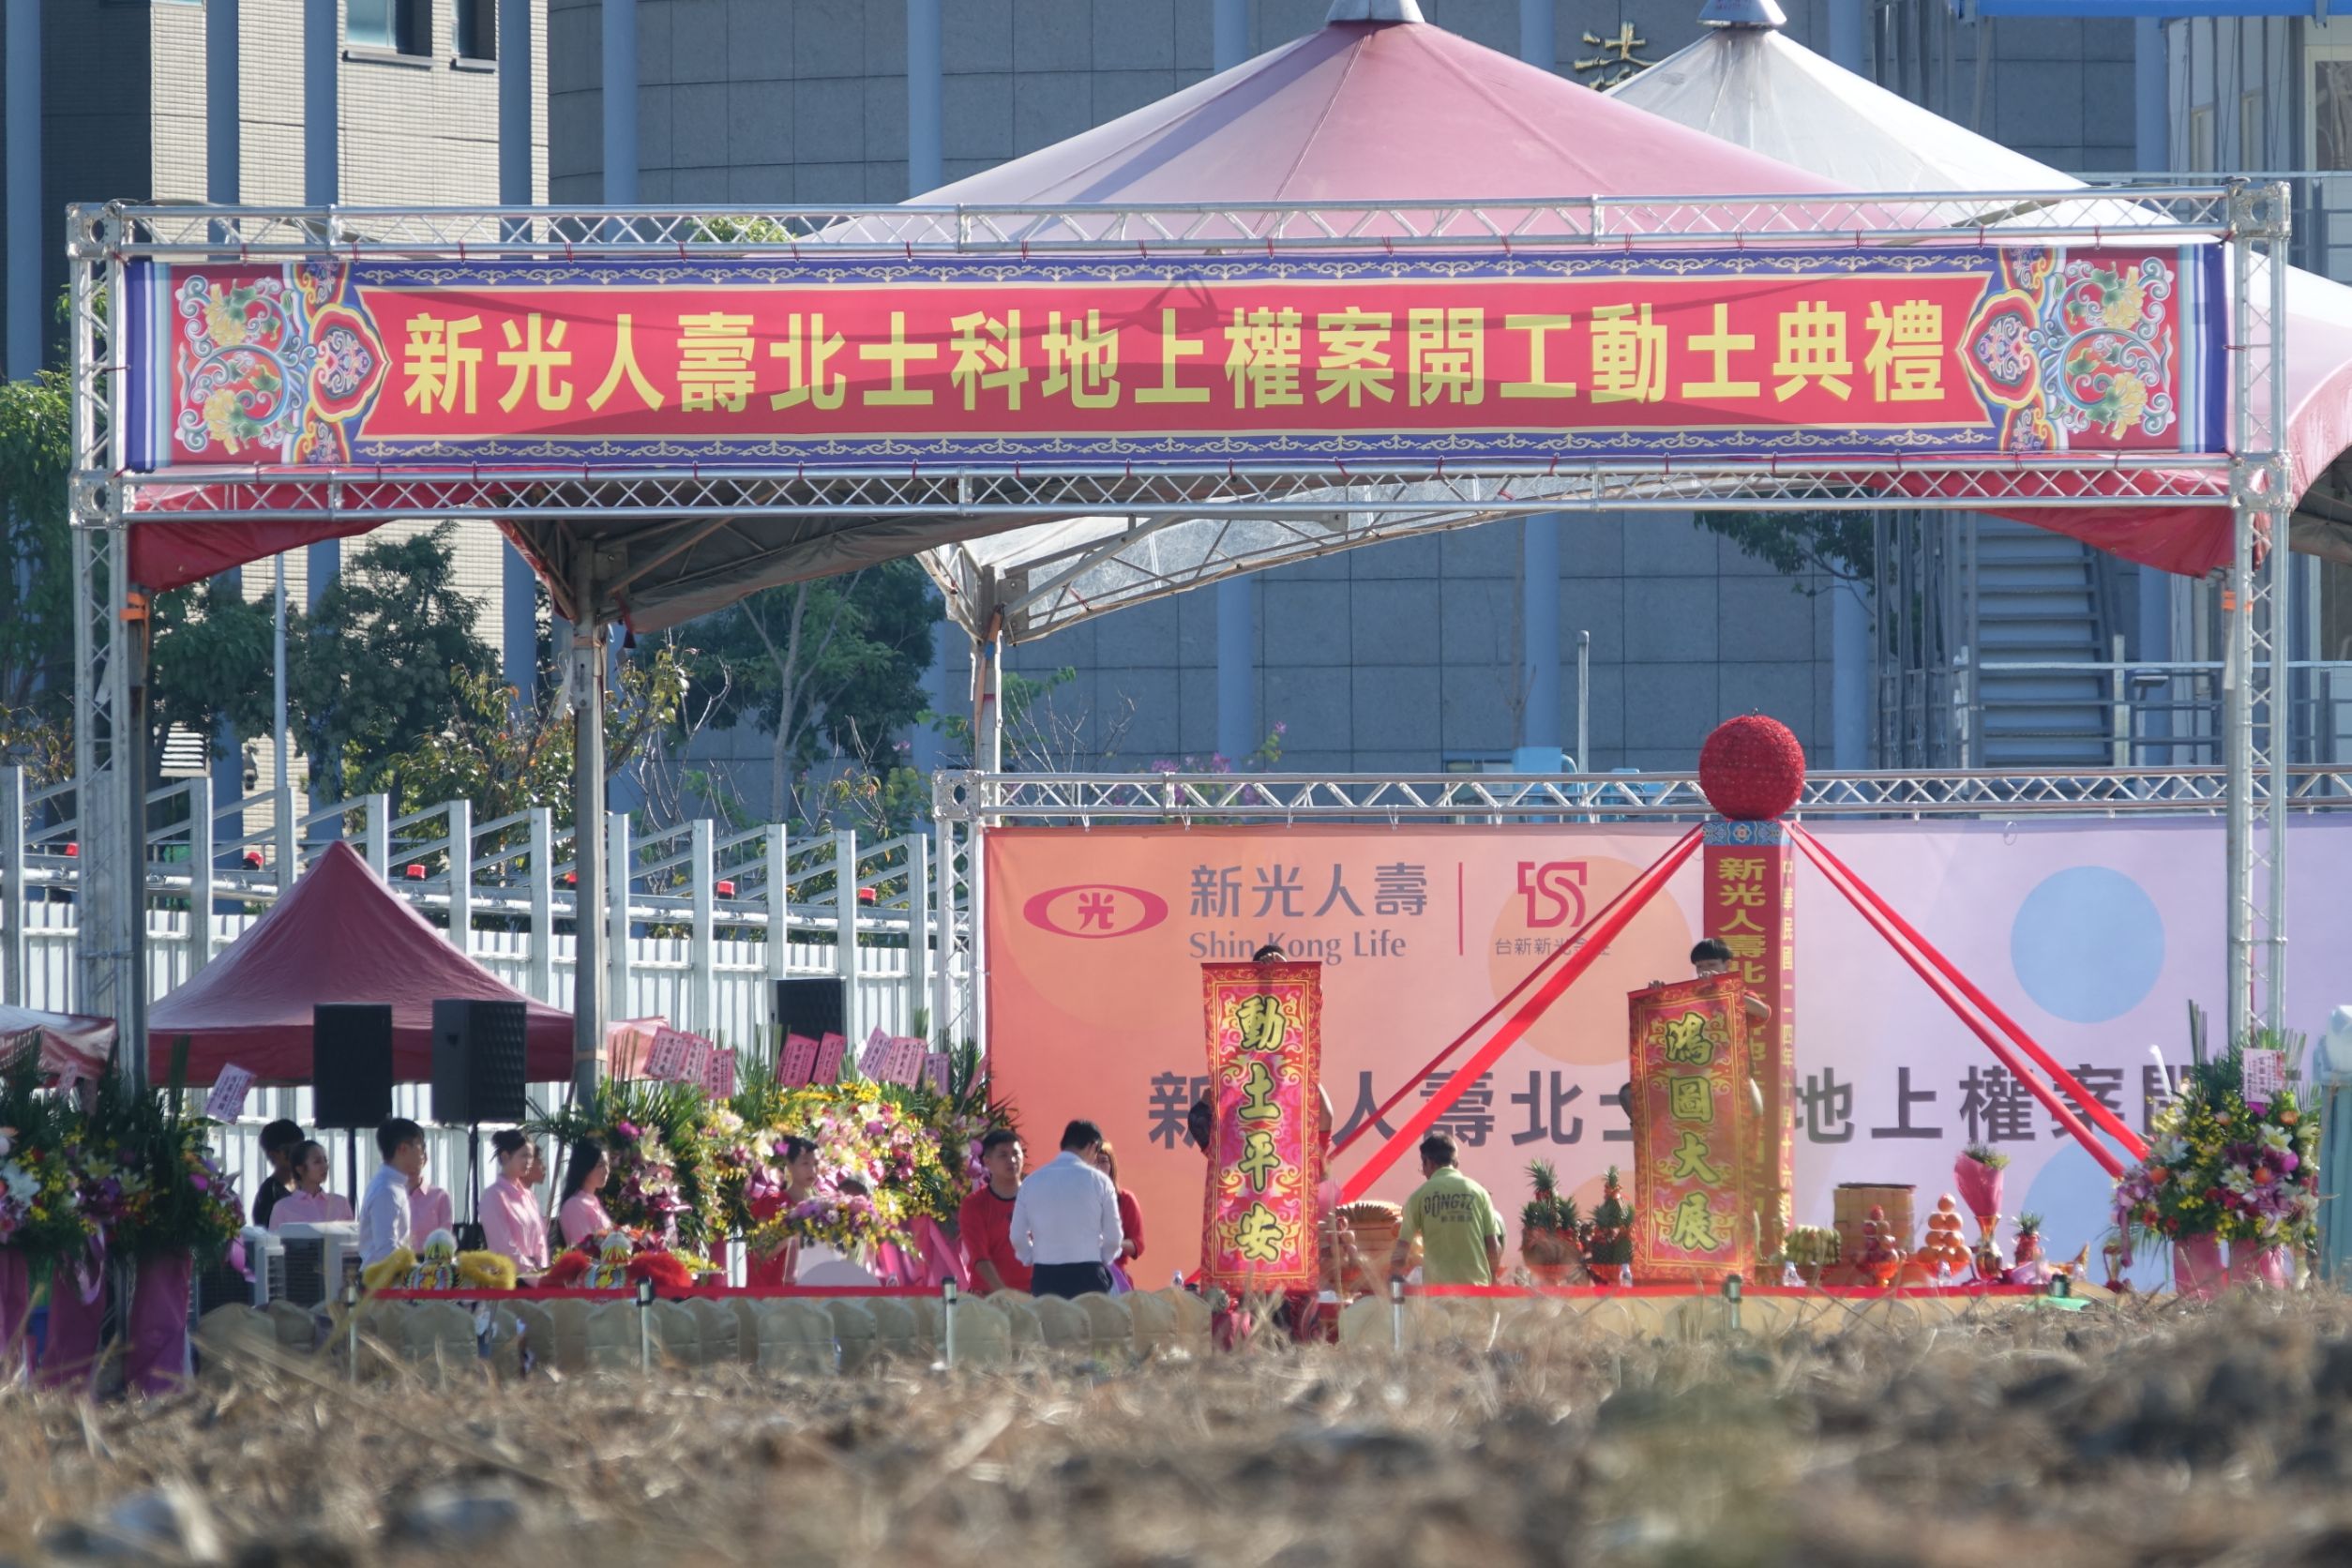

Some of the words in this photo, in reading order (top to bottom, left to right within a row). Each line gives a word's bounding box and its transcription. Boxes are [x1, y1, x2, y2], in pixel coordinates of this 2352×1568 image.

[402, 299, 1945, 415] 新光人壽北士科地上權案開工動土典禮
[1189, 861, 1427, 918] 新光人壽
[1189, 930, 1255, 958] Shin
[1267, 931, 1342, 966] Kong
[1353, 928, 1407, 957] Life
[1234, 994, 1287, 1263] 動土平安
[1665, 1011, 1722, 1252] 鴻圖大展
